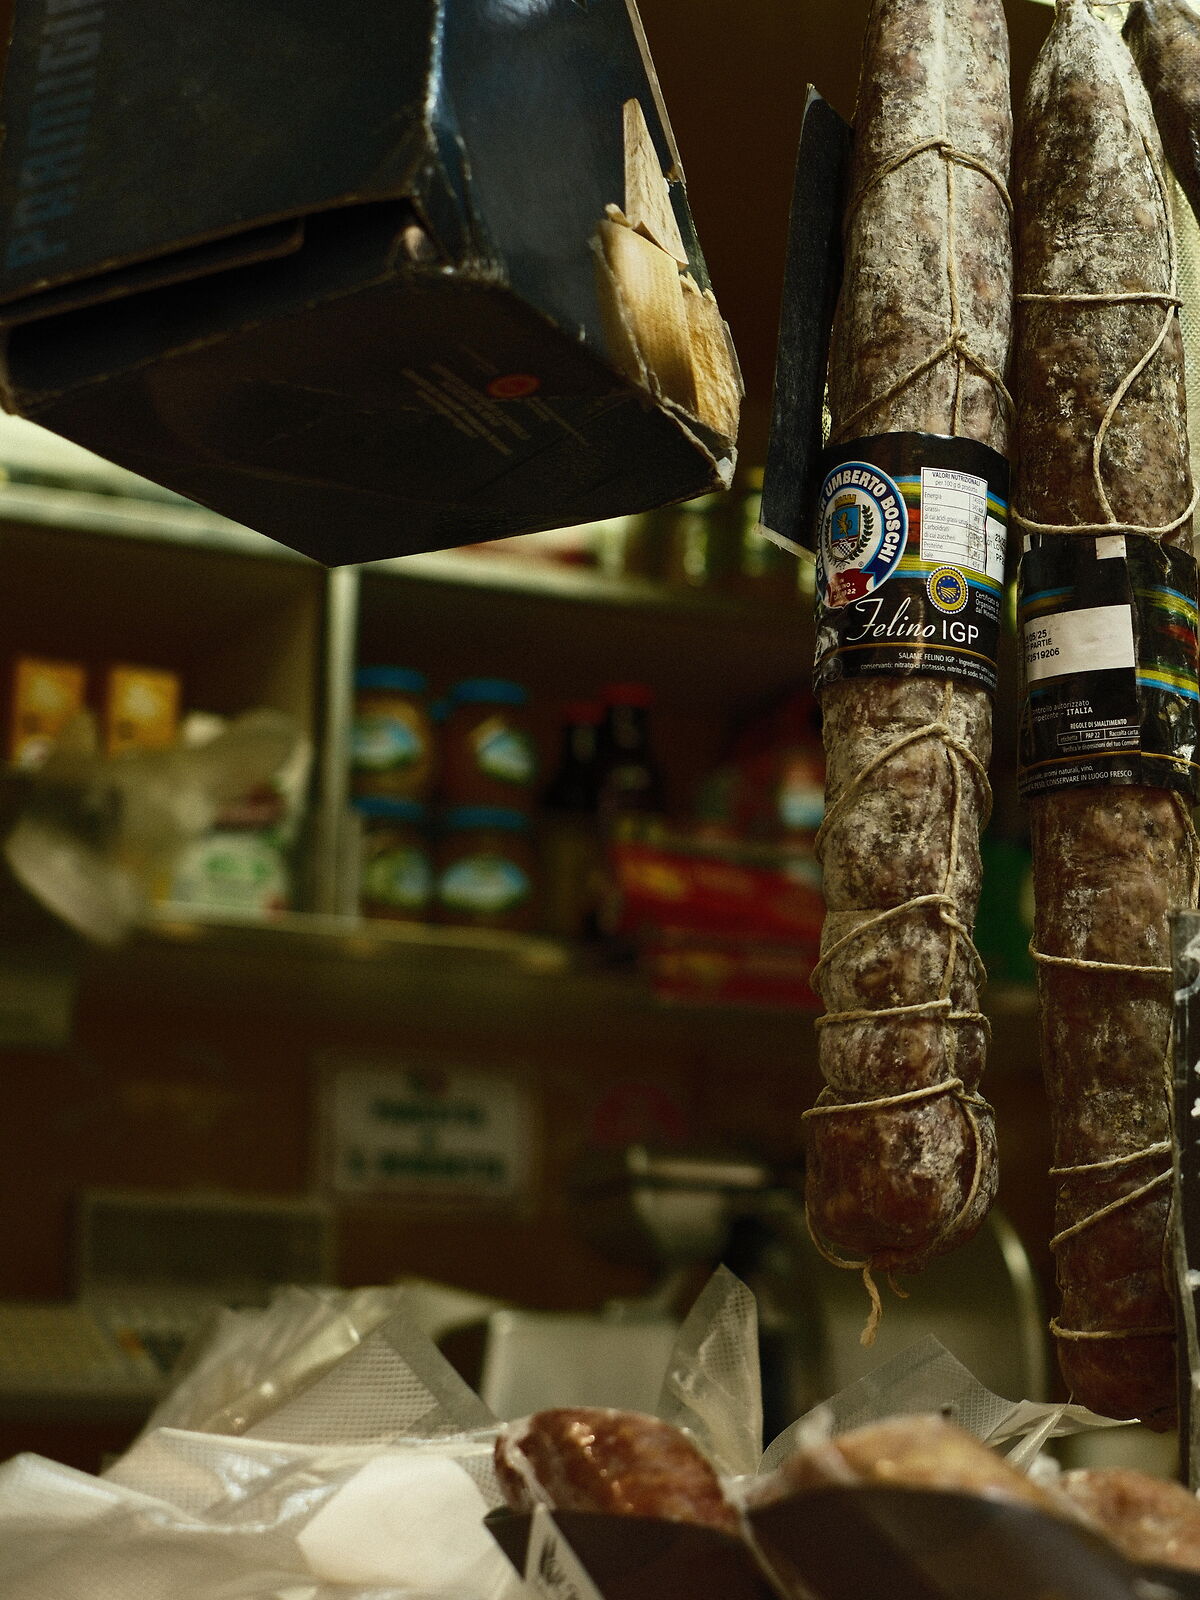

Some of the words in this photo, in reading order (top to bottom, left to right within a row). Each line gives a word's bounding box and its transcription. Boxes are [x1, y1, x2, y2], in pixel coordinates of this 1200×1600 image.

[932, 471, 950, 479] VALORI
[824, 469, 887, 498] UMBERTO
[877, 495, 901, 564] BOSCHI
[846, 596, 936, 641] Felino
[942, 619, 979, 645] IGP
[898, 652, 923, 660] SALAME
[924, 654, 945, 662] FELINO
[894, 661, 914, 669] nitrato
[1053, 699, 1090, 711] autorizzato
[1066, 706, 1093, 716] ITALIA
[1070, 721, 1087, 730] REGOLE
[1087, 720, 1094, 728] DI
[1094, 718, 1128, 728] SMALTIMENTO
[1094, 731, 1101, 739] 22
[1108, 728, 1127, 737] Raccolta
[1105, 740, 1113, 748] del
[1121, 739, 1139, 747] Comune
[1046, 775, 1080, 787] CONSERVARE
[1080, 773, 1087, 781] IN
[1087, 771, 1109, 781] LUOGO
[1109, 769, 1133, 779] FRESCO
